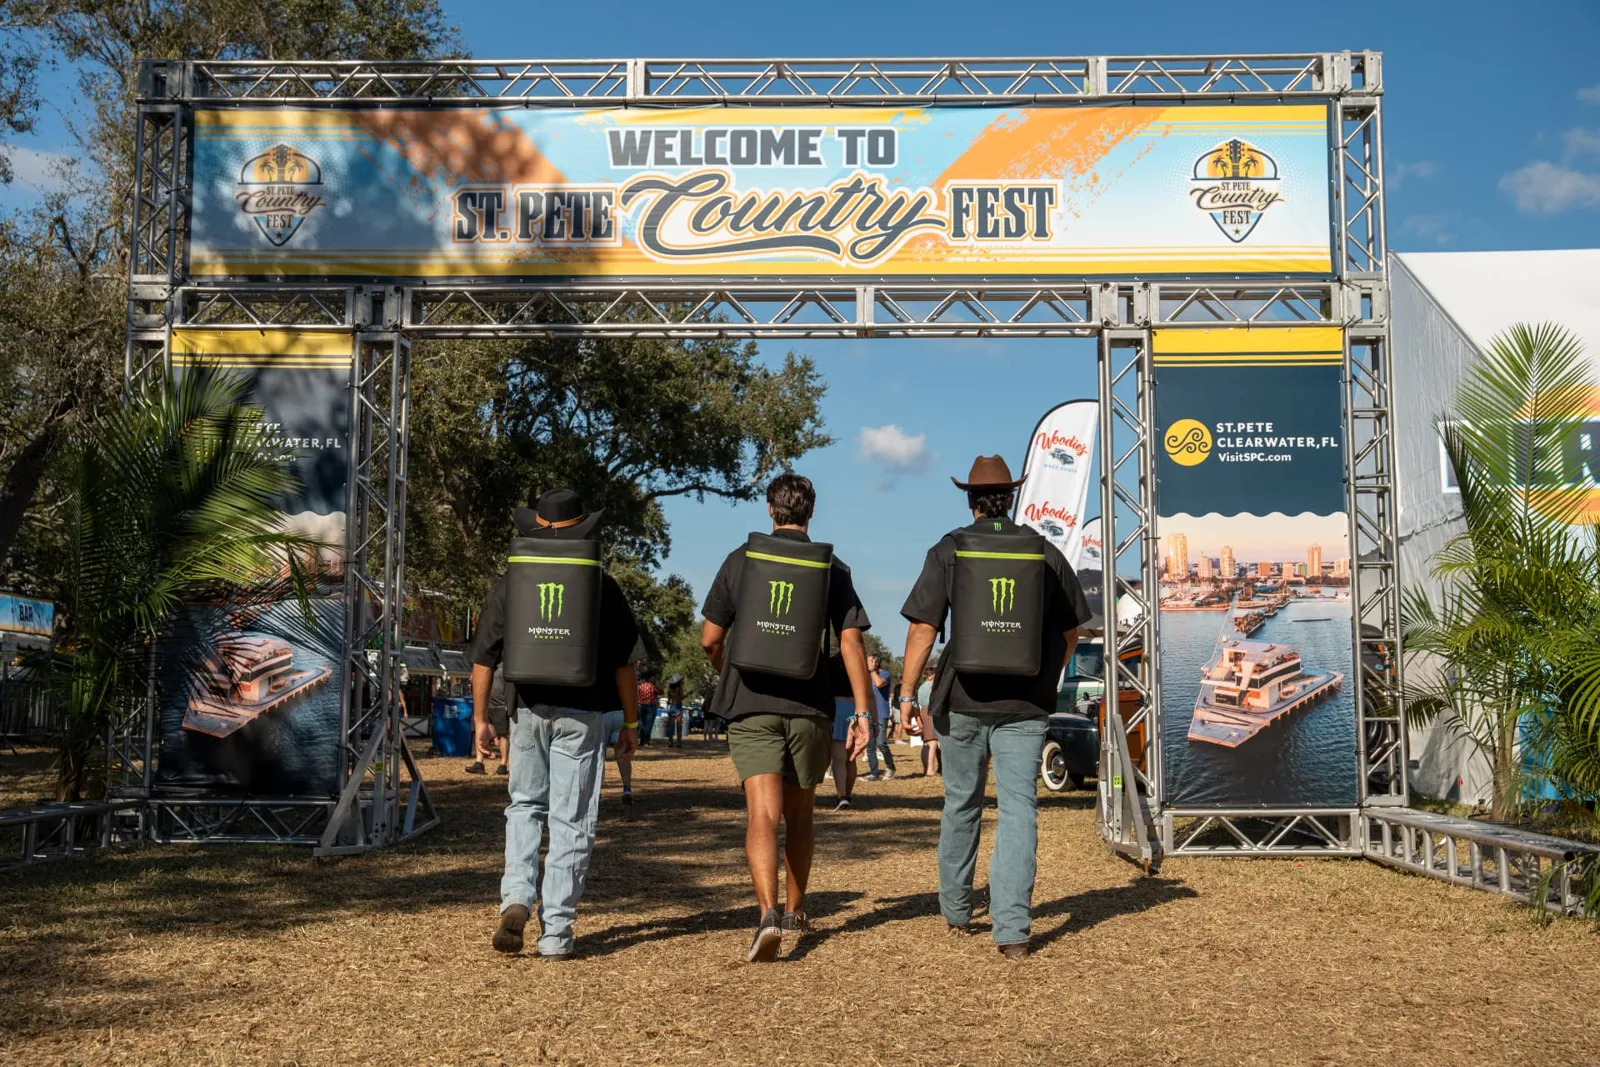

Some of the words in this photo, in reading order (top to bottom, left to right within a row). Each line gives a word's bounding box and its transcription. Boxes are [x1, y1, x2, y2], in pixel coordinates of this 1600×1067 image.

[609, 129, 823, 167] WELCOME
[841, 129, 896, 167] TO
[1233, 182, 1251, 191] PETE
[236, 190, 326, 215] Country
[1190, 186, 1285, 211] Country
[266, 214, 293, 228] FEST
[623, 172, 948, 260] Country
[950, 187, 1055, 238] FEST
[1223, 210, 1251, 224] FEST
[1218, 452, 1292, 462] VisitSPC.com
[20, 605, 34, 622] BAR
[528, 627, 570, 635] MONSTER
[756, 620, 796, 632] MONSTER
[981, 620, 1021, 628] MONSTER
